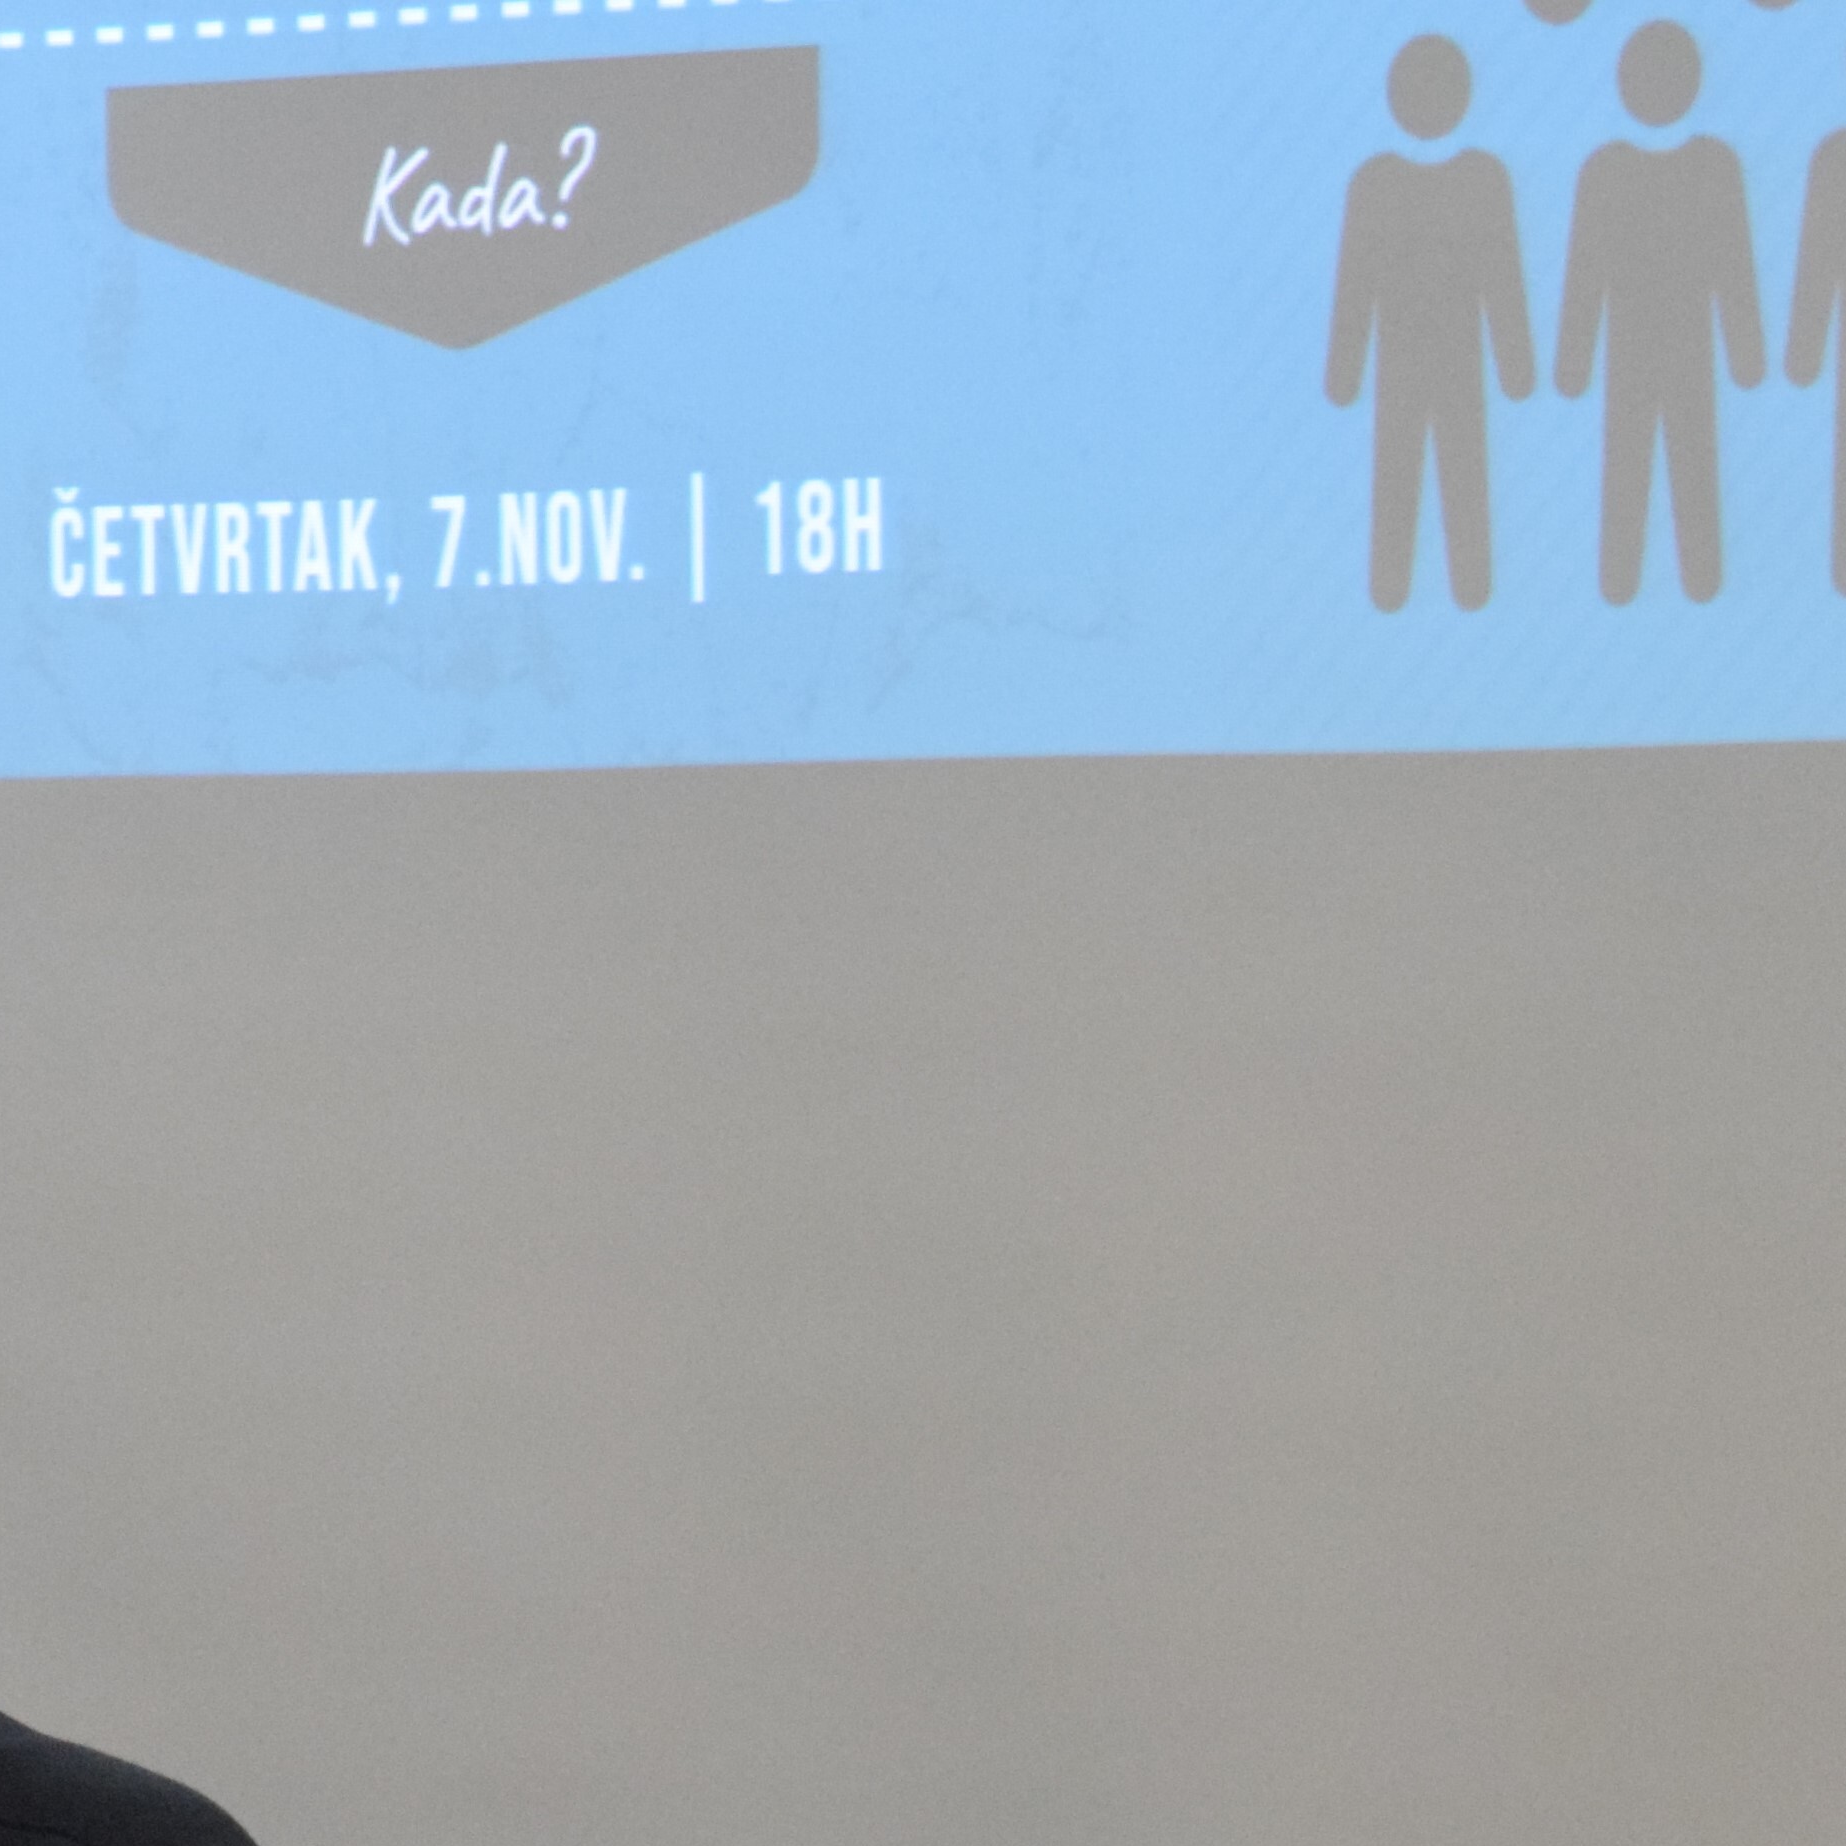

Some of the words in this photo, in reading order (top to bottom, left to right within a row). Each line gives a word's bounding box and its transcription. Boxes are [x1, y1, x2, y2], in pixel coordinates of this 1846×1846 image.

[362, 124, 599, 248] Kada?
[49, 485, 404, 604] ČETVRTAK,
[430, 486, 645, 590] 7.NOV.
[754, 476, 884, 576] 18H
